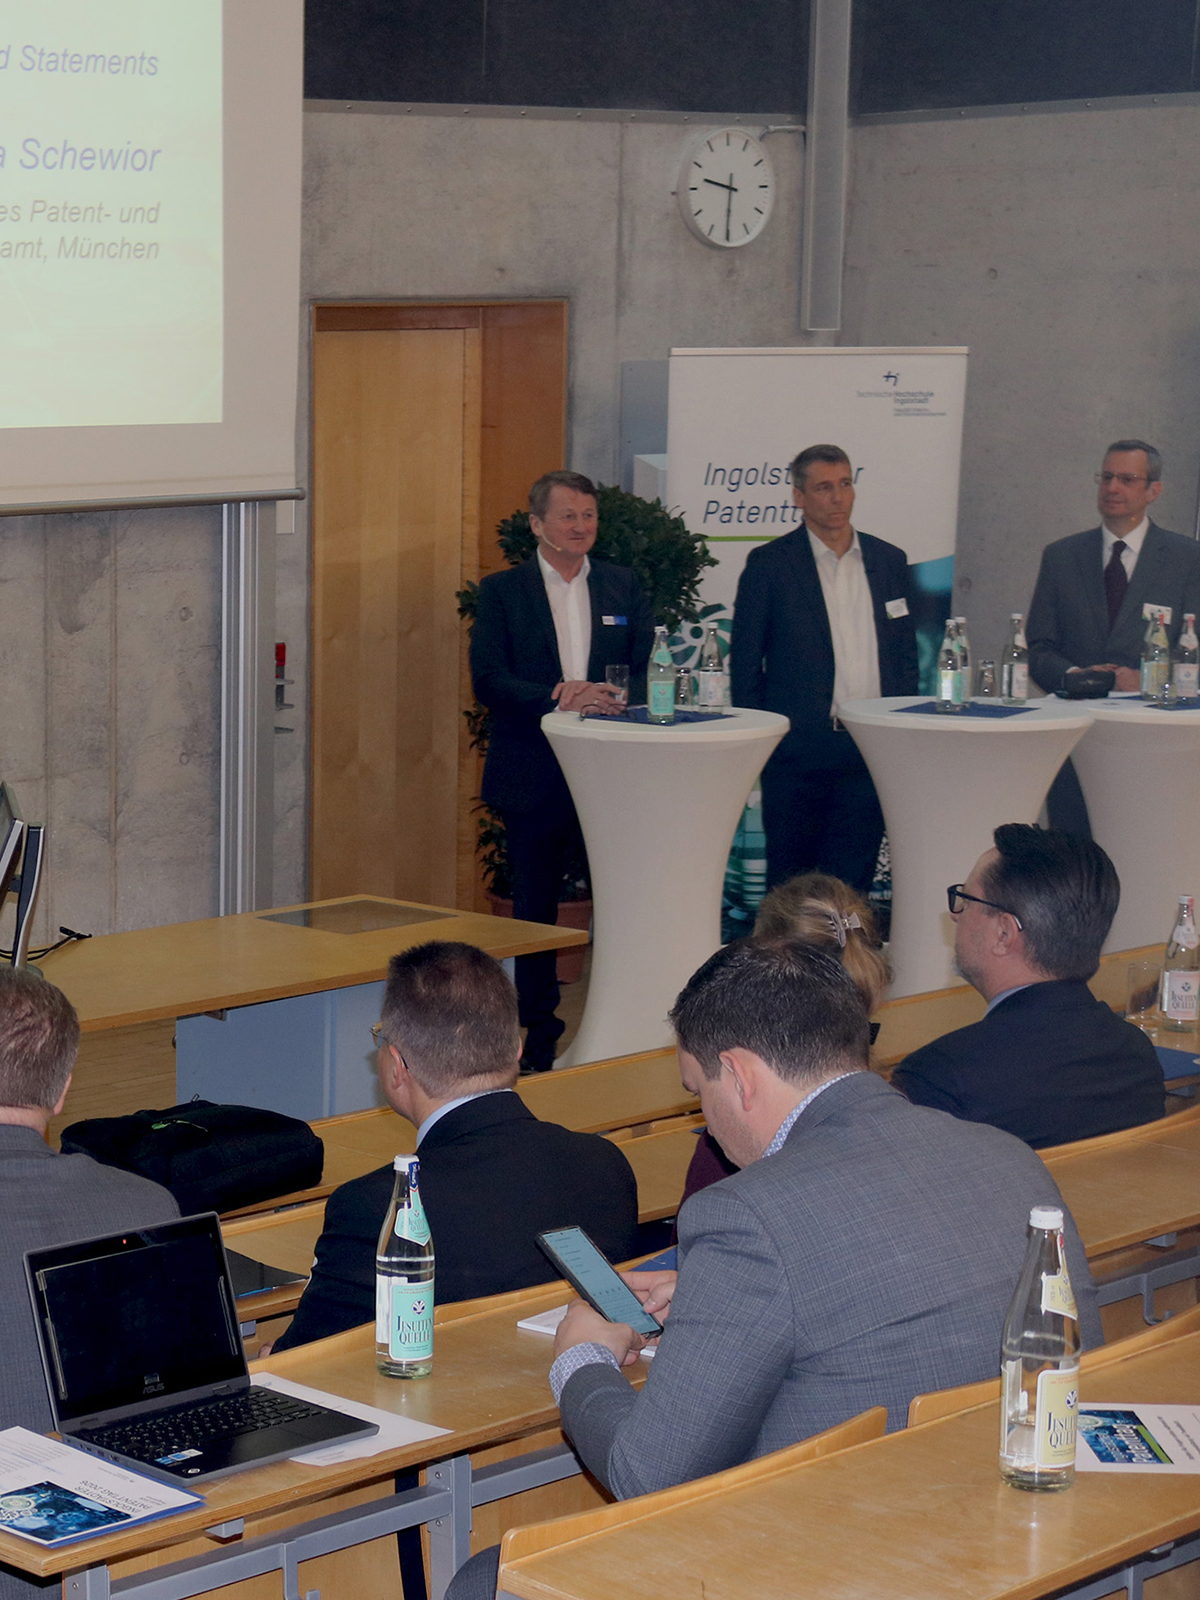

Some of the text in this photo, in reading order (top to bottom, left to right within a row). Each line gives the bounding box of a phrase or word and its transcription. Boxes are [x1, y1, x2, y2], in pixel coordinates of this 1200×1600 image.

[19, 44, 159, 76] Statements
[19, 137, 162, 172] Schewior
[29, 199, 111, 224] Patent-
[119, 201, 160, 224] und
[56, 235, 160, 260] München
[703, 462, 864, 492] Ingolstr
[703, 500, 804, 524] Patentt
